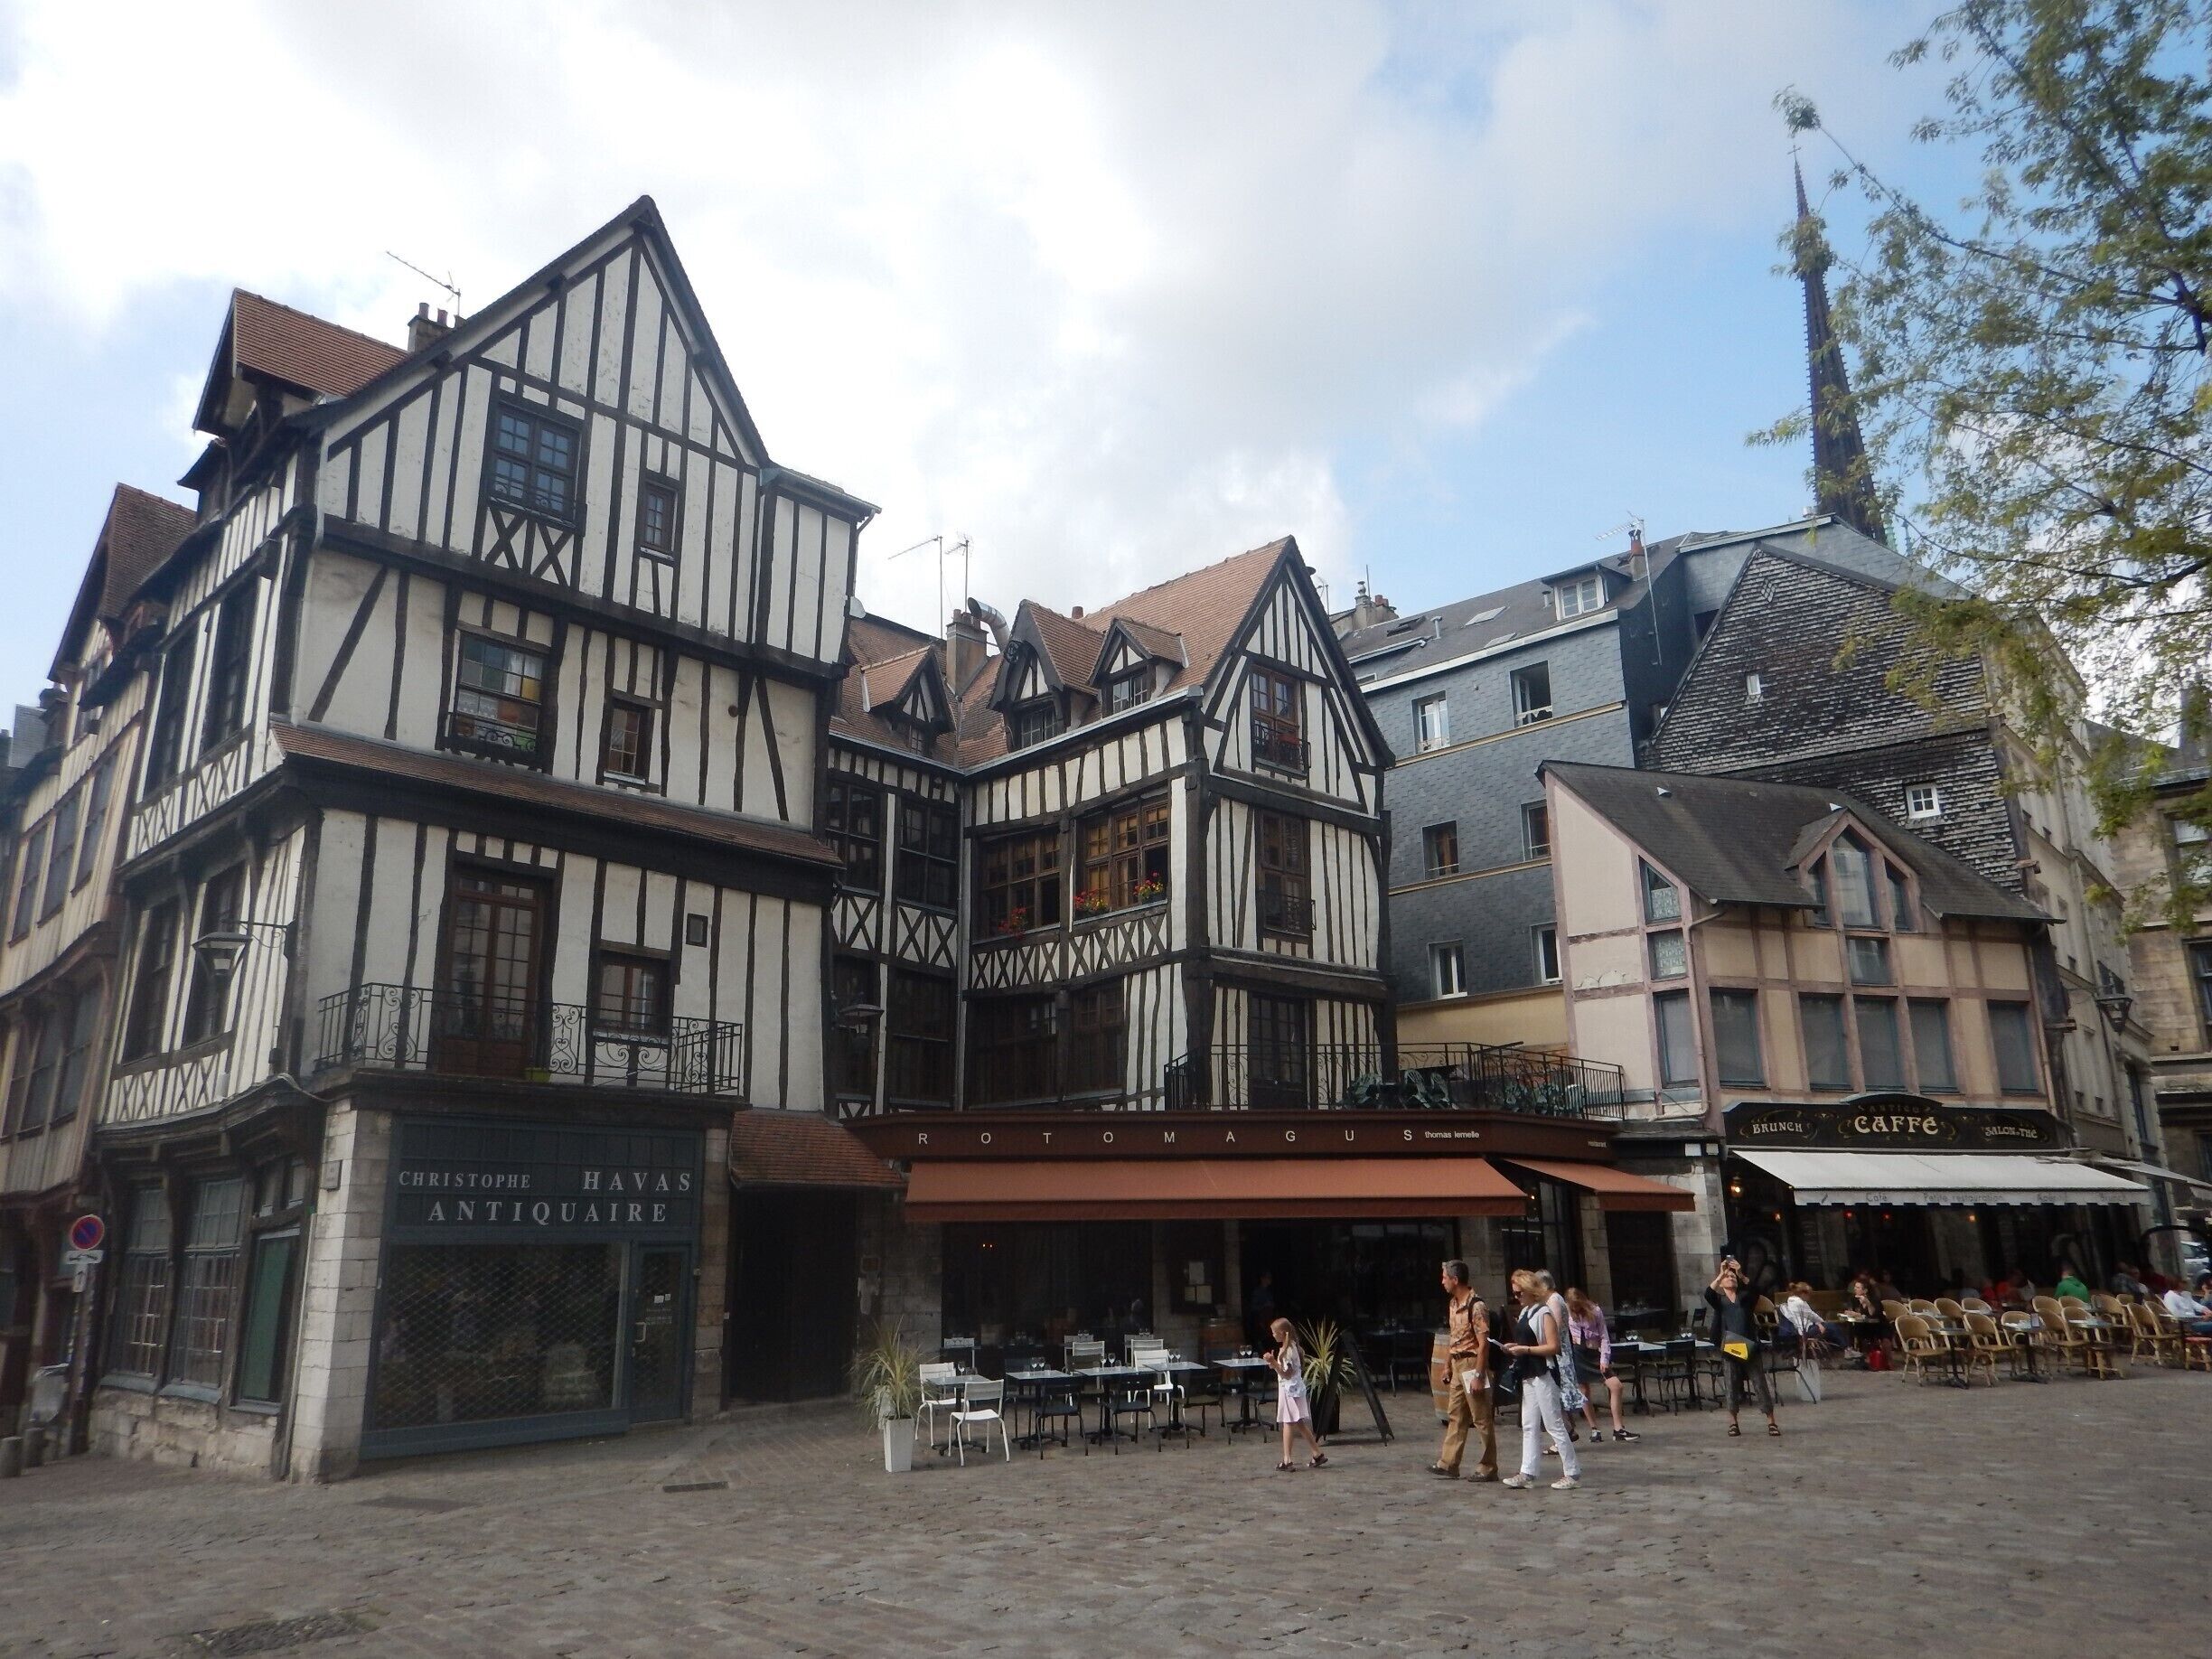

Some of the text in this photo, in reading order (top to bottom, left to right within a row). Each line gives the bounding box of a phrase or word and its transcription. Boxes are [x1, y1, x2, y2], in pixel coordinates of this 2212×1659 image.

[1424, 1130, 1452, 1139] thomas
[1752, 1121, 1804, 1135] BRUNCH
[398, 1170, 691, 1192] CHRISTOPHE HAVAS
[427, 1200, 667, 1226] ANTIQUAIRE
